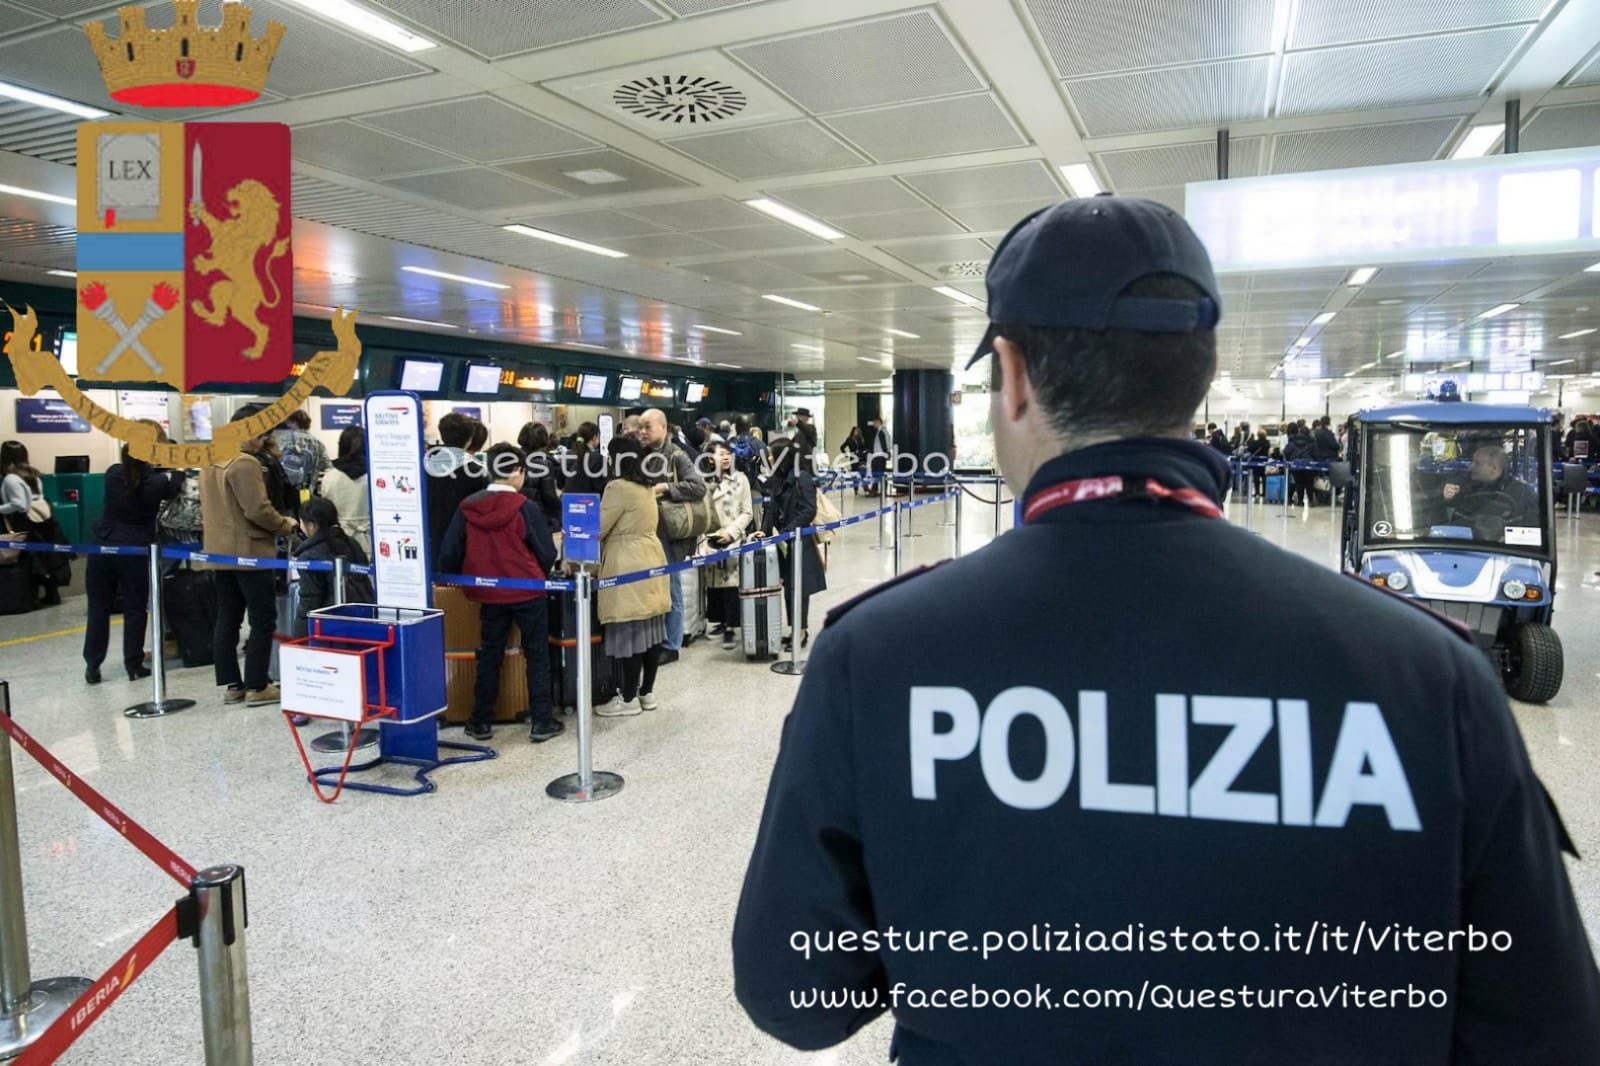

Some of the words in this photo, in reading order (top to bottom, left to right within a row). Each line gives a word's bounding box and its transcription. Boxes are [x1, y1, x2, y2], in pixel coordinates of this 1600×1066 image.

[3, 331, 42, 353] 21
[909, 686, 1422, 832] POLIZIA
[71, 976, 119, 1031] IBERIA
